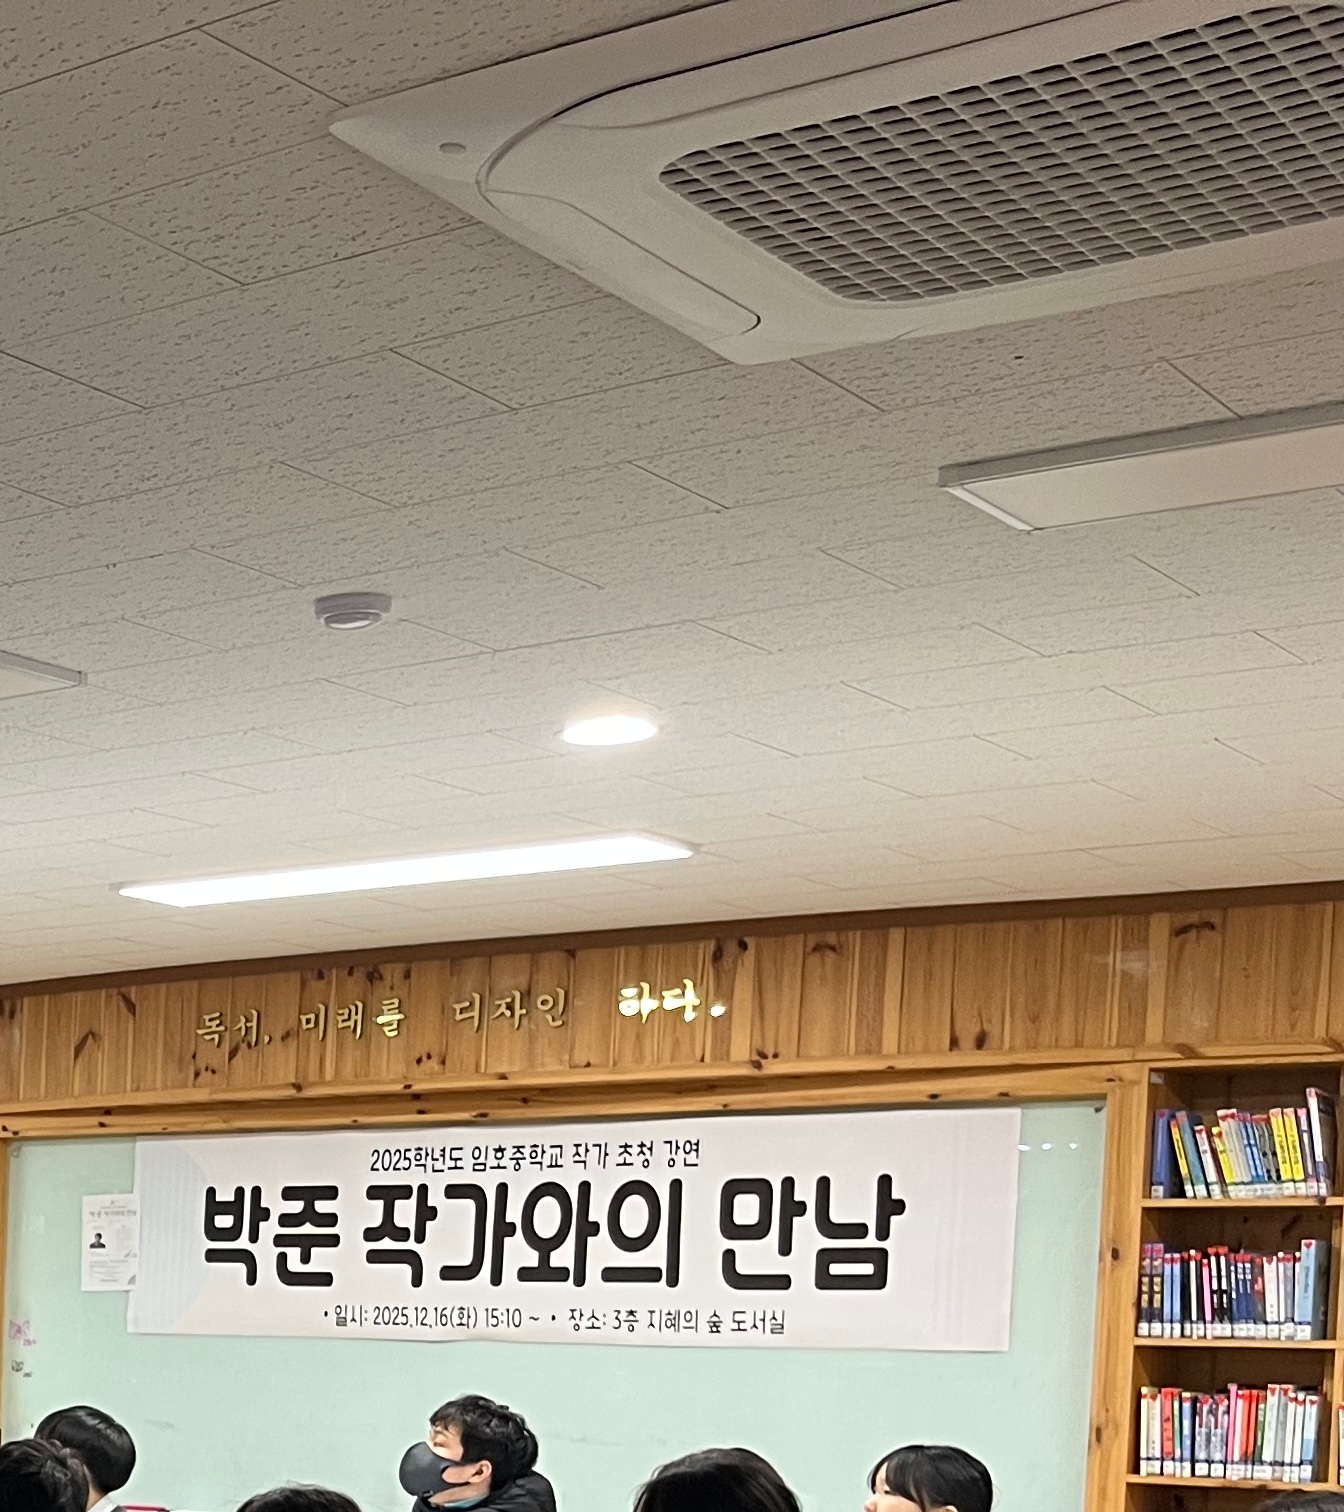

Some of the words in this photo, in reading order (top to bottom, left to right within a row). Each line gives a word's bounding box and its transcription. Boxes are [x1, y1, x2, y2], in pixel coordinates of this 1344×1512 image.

[196, 1009, 271, 1048] 독서,
[300, 998, 405, 1041] 미래를
[452, 987, 566, 1033] 디자인
[618, 978, 726, 1024] 하다.
[371, 1147, 464, 1173] 2025학년도
[472, 1144, 563, 1172] 임호중학교
[573, 1142, 609, 1170] 작가
[616, 1141, 653, 1168] 초청
[664, 1139, 699, 1167] 강연
[204, 1185, 340, 1287] 박준
[363, 1178, 682, 1288] 작가와의
[720, 1174, 906, 1290] 만남
[335, 1305, 367, 1326] 일시:
[374, 1306, 477, 1329] 2025.12.16(화)
[485, 1308, 521, 1328] 15:10
[569, 1309, 606, 1331] 장소:
[613, 1310, 639, 1332] 3층
[648, 1309, 698, 1333] 지혜의
[707, 1310, 723, 1333] 숲
[731, 1310, 784, 1334] 도서실
